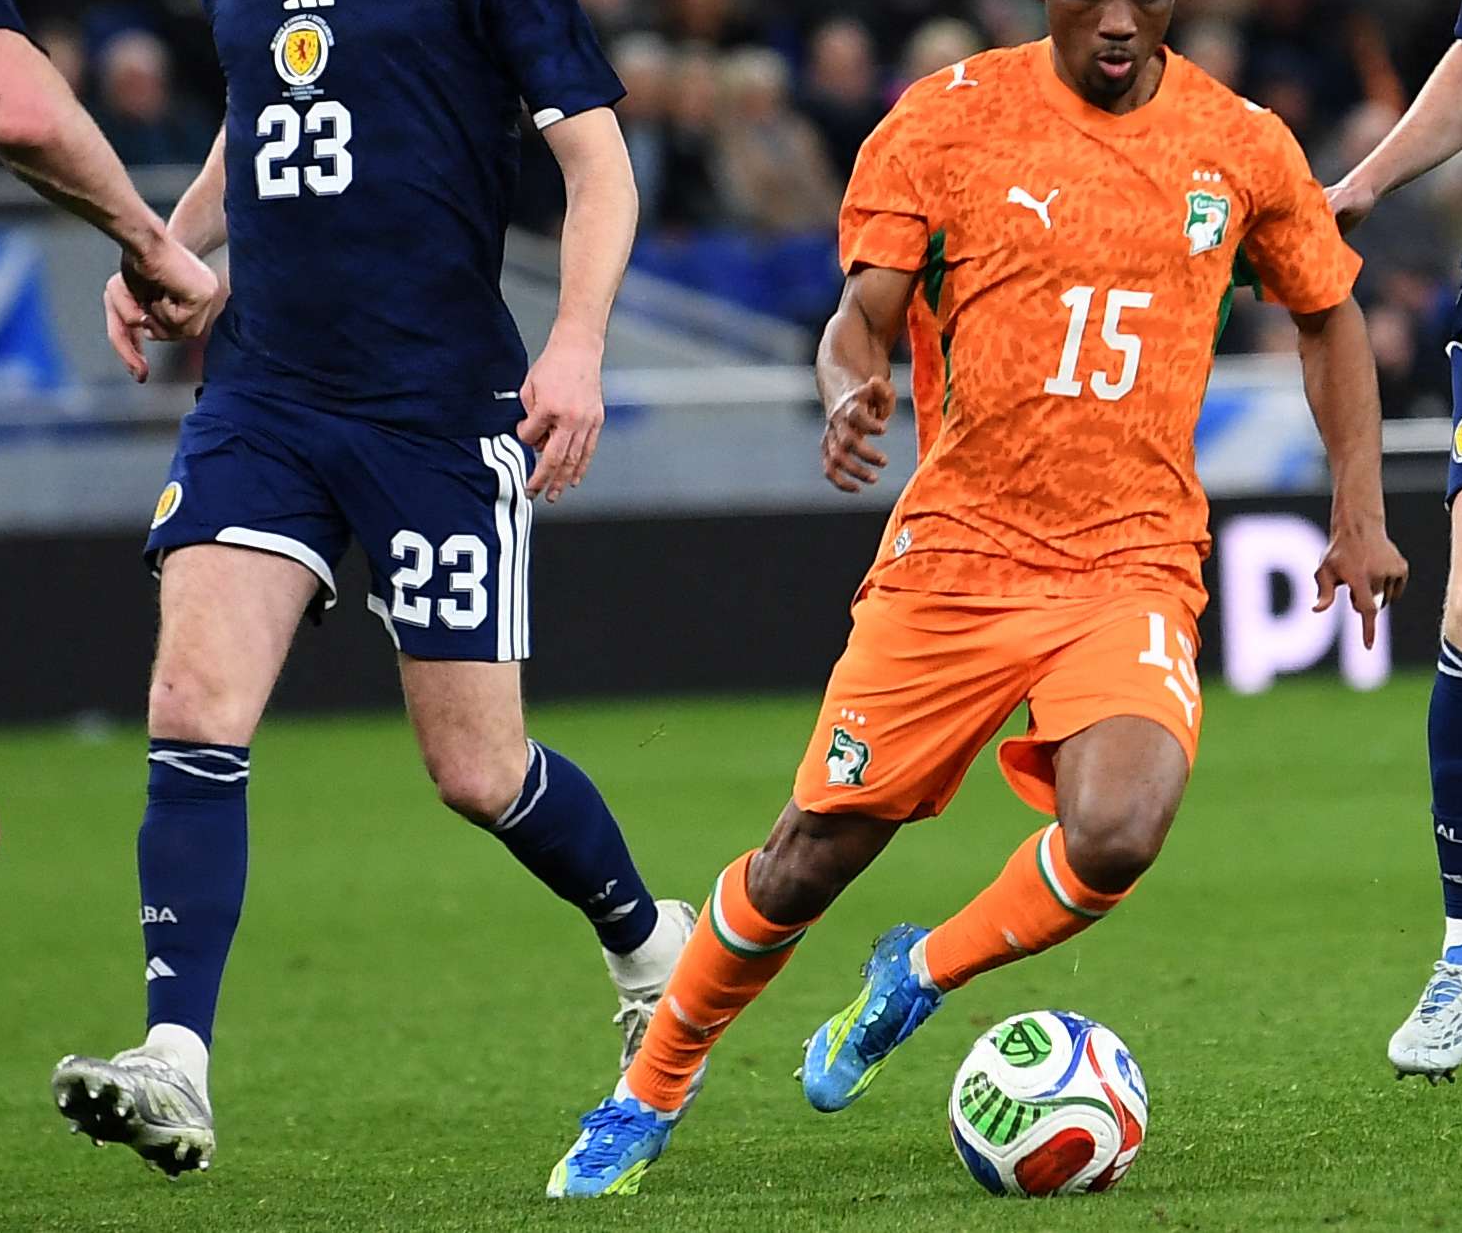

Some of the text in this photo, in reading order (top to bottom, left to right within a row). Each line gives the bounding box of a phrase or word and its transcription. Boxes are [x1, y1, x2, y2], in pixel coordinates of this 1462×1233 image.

[254, 100, 353, 199] 23
[1044, 285, 1153, 401] 15
[389, 529, 488, 629] 23
